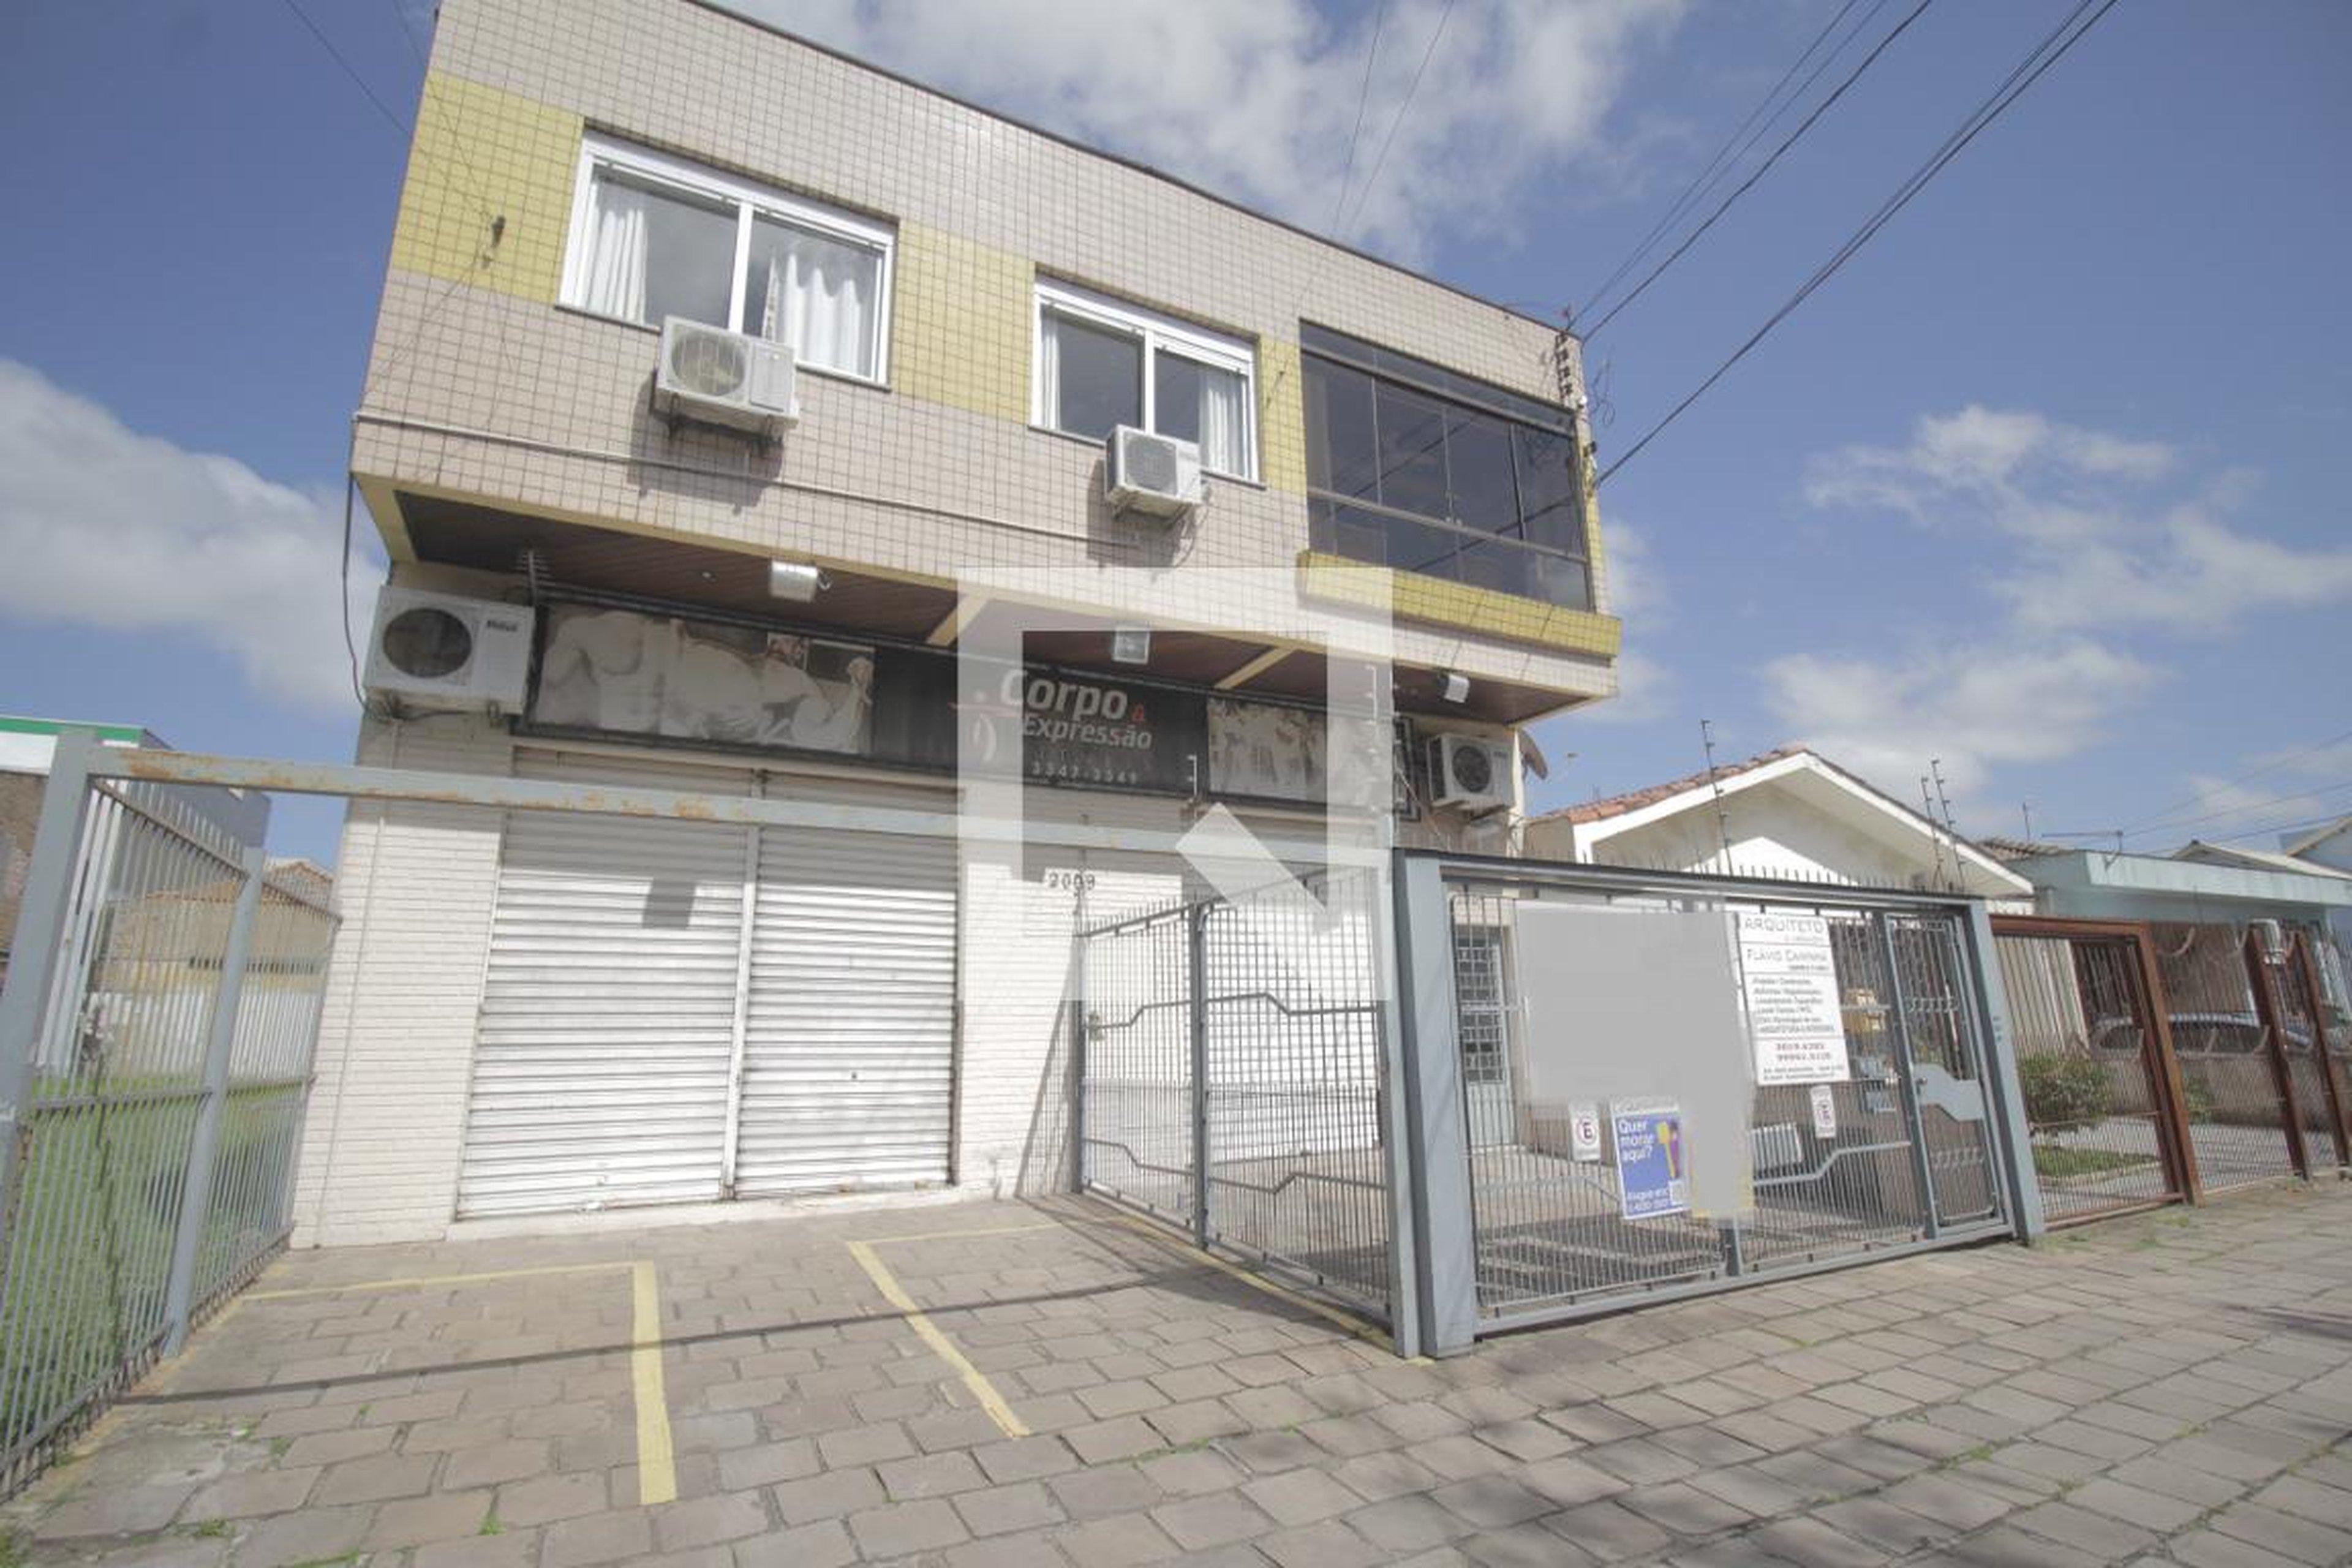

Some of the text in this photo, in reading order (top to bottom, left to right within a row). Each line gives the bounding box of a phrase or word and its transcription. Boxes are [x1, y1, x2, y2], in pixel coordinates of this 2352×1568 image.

[1000, 668, 1128, 721] Corpo
[1022, 715, 1151, 749] Expressão
[1746, 918, 1824, 933] ARQUITETO
[1618, 1119, 1648, 1134] Quer
[1622, 1145, 1653, 1164] aqui?
